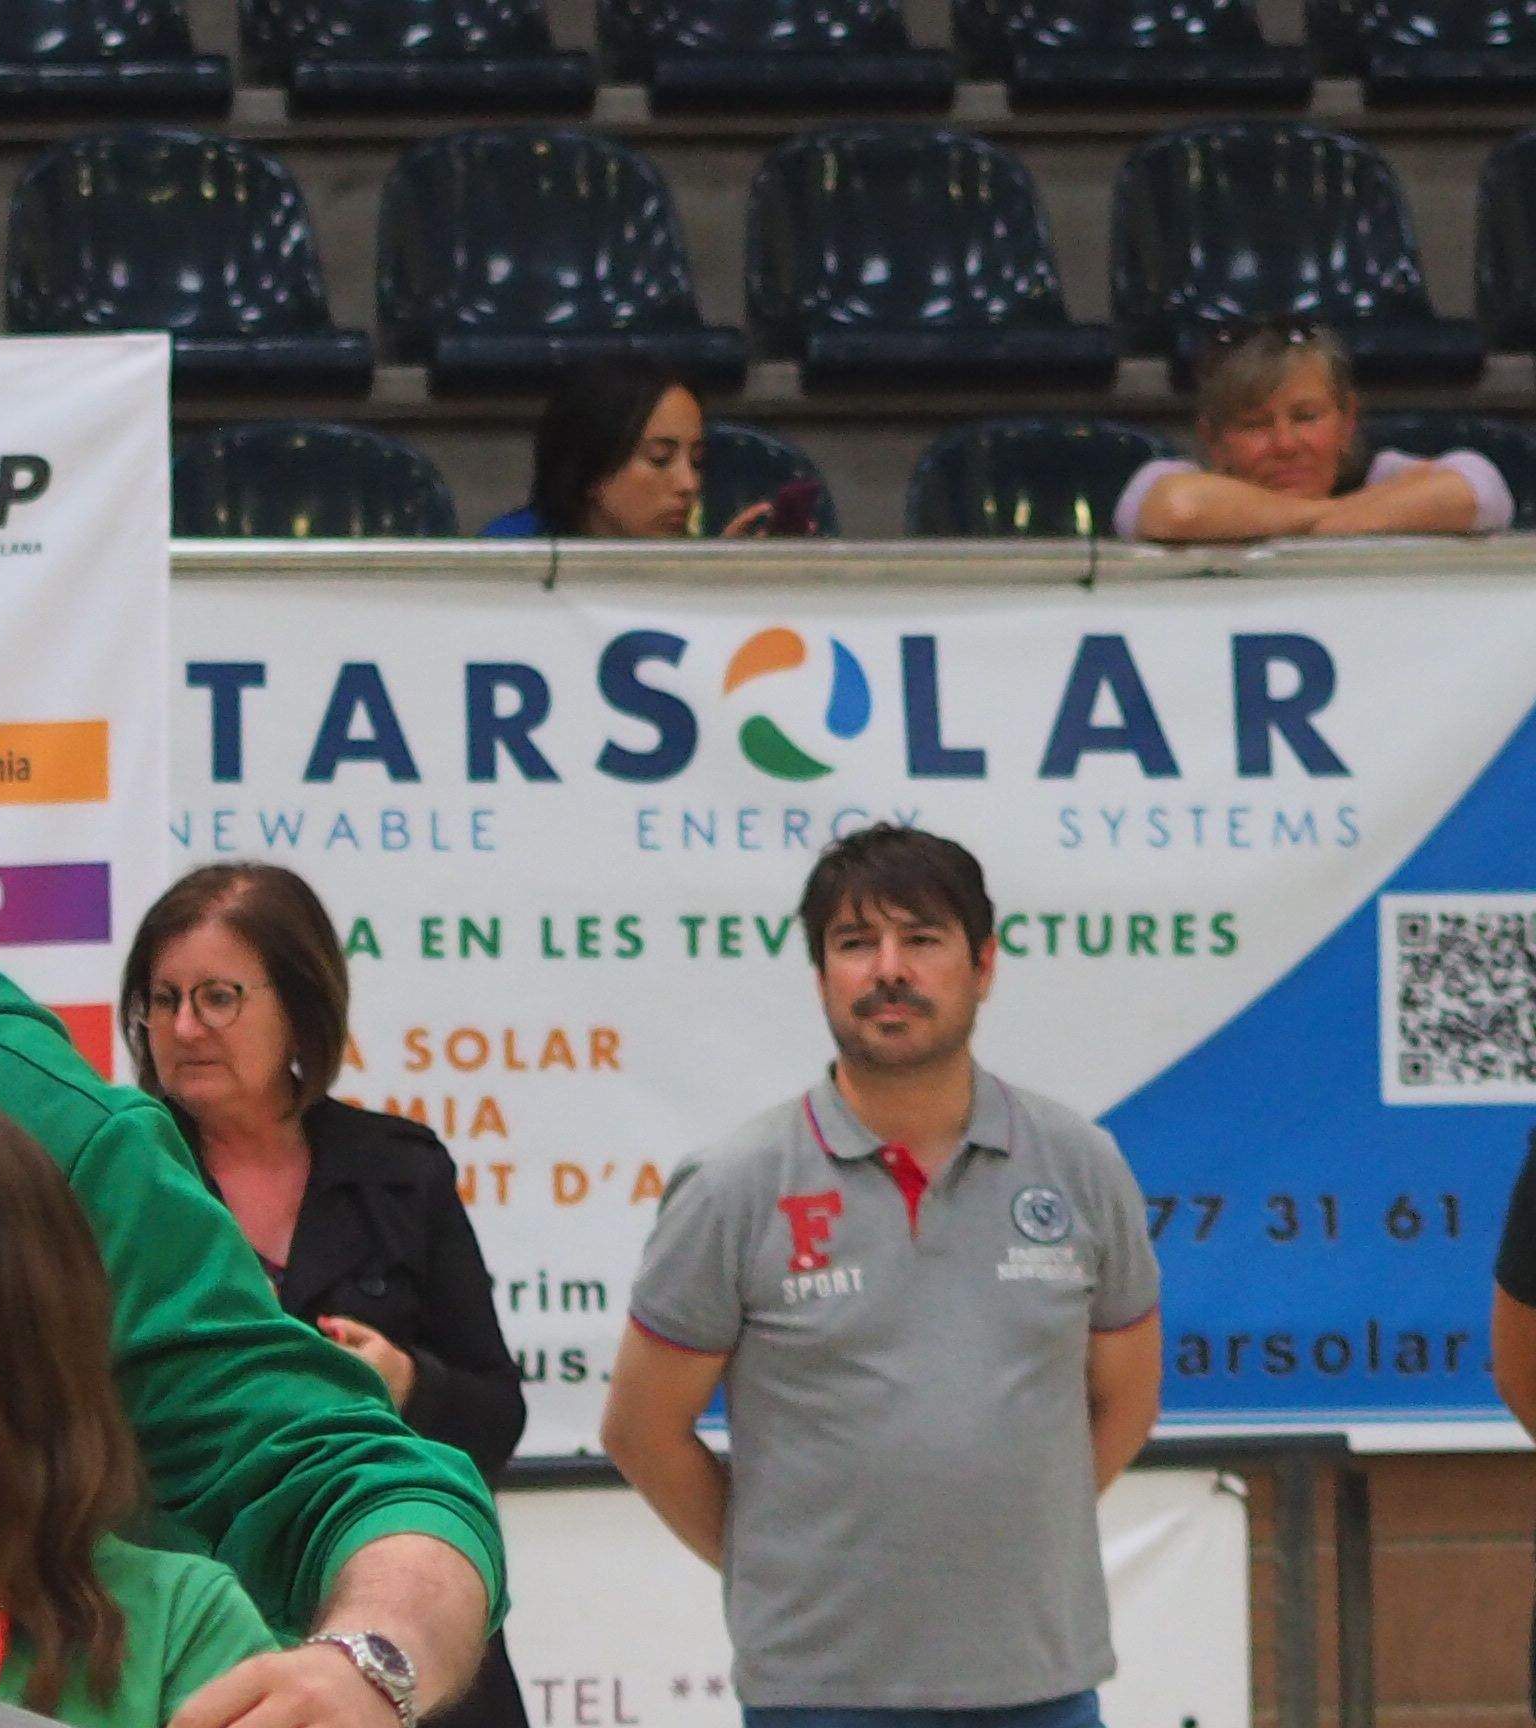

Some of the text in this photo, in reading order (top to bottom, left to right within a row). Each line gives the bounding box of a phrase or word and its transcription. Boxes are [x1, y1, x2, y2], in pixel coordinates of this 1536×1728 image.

[1060, 807, 1362, 850] SYSTEMS
[420, 916, 502, 959] EN
[542, 916, 645, 959] LES
[403, 1027, 622, 1072] SOLAR
[1266, 1195, 1340, 1242] 31
[1385, 1194, 1463, 1241] 61
[780, 1265, 866, 1304] SPORT
